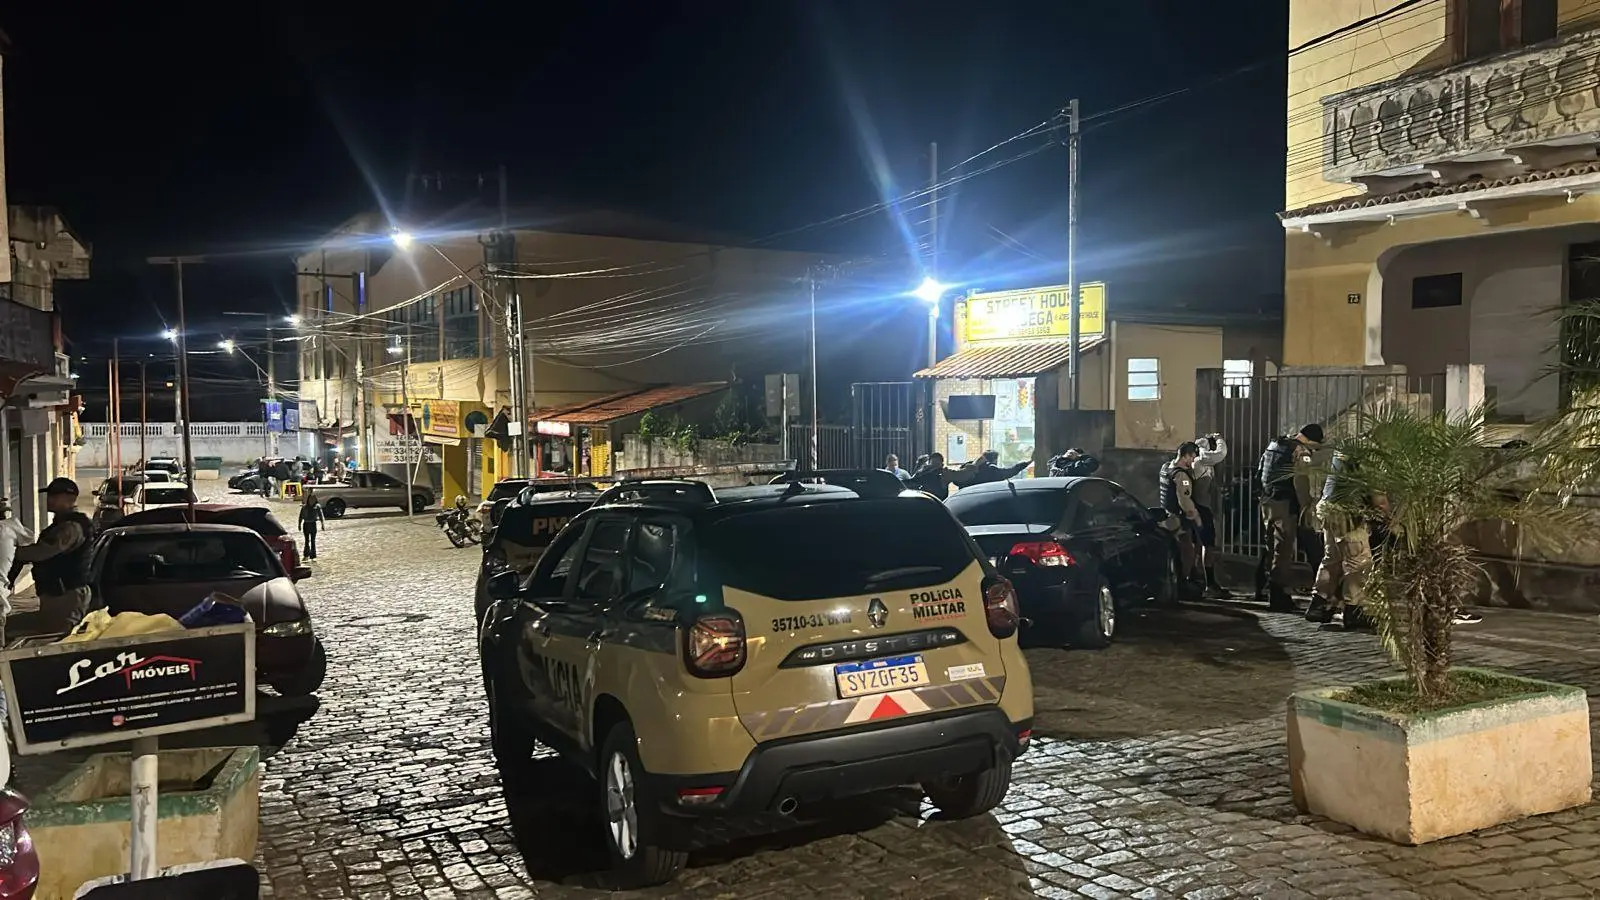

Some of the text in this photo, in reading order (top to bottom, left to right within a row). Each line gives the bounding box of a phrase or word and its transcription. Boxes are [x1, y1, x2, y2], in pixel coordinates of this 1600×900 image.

[1041, 290, 1085, 308] HOUE
[913, 602, 966, 619] MILITAR
[821, 633, 938, 658] DUSTER
[56, 652, 145, 694] Lar
[131, 664, 190, 680] MÓVEIS
